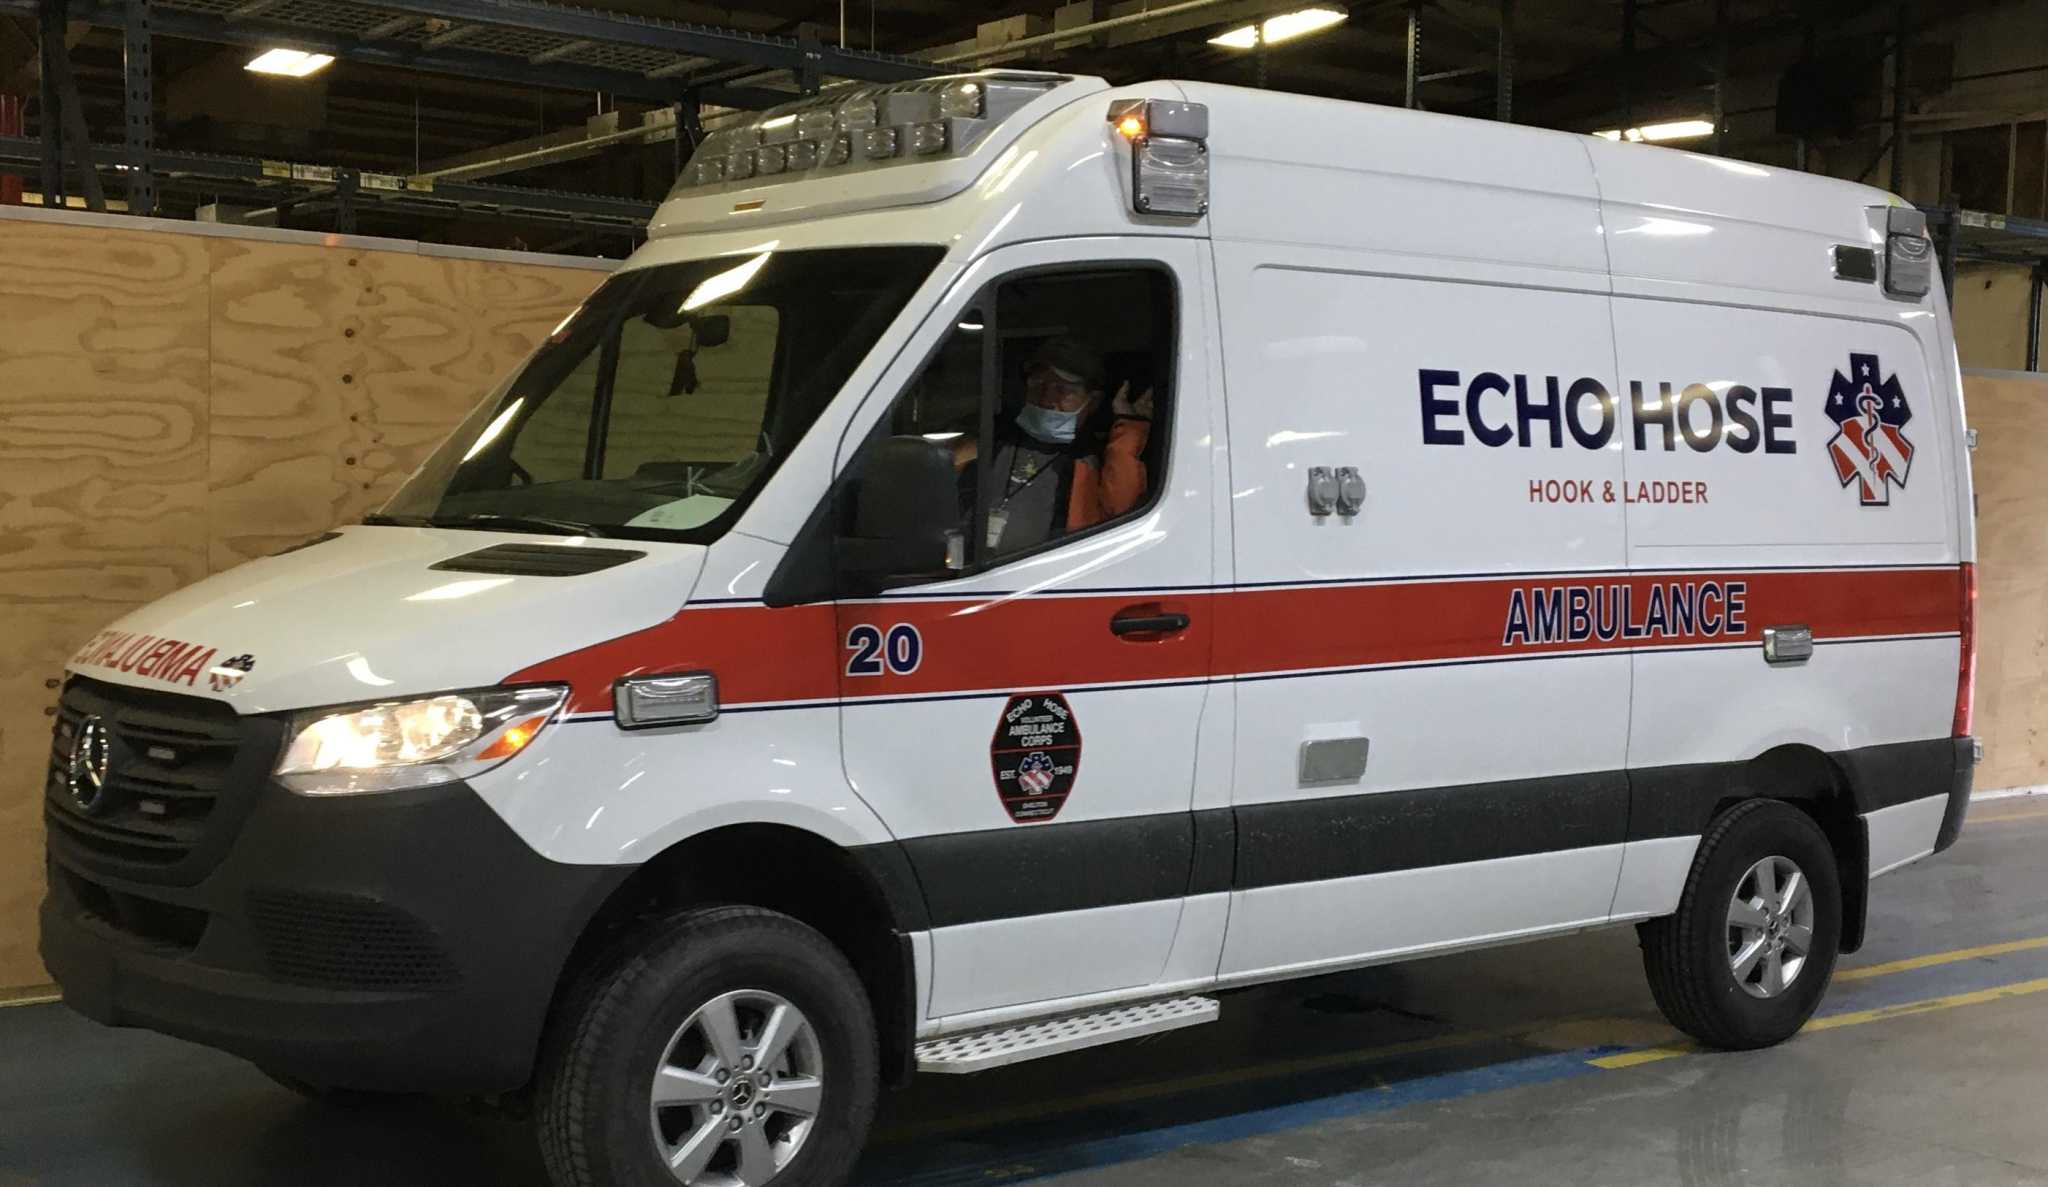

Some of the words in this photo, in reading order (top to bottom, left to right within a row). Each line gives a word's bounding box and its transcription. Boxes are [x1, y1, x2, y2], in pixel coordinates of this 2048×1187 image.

[1418, 368, 1616, 450] ECHO
[1629, 379, 1798, 455] HOSE
[1529, 479, 1594, 503] HOOK
[1601, 480, 1616, 503] &
[1623, 480, 1709, 504] LADDER
[1501, 580, 1747, 647] AMBULANCE
[845, 622, 923, 677] 20
[1006, 699, 1032, 722] ECHO
[1043, 698, 1069, 720] HOSE
[1008, 722, 1064, 736] AMBULANCE
[1021, 735, 1053, 747] CORPS
